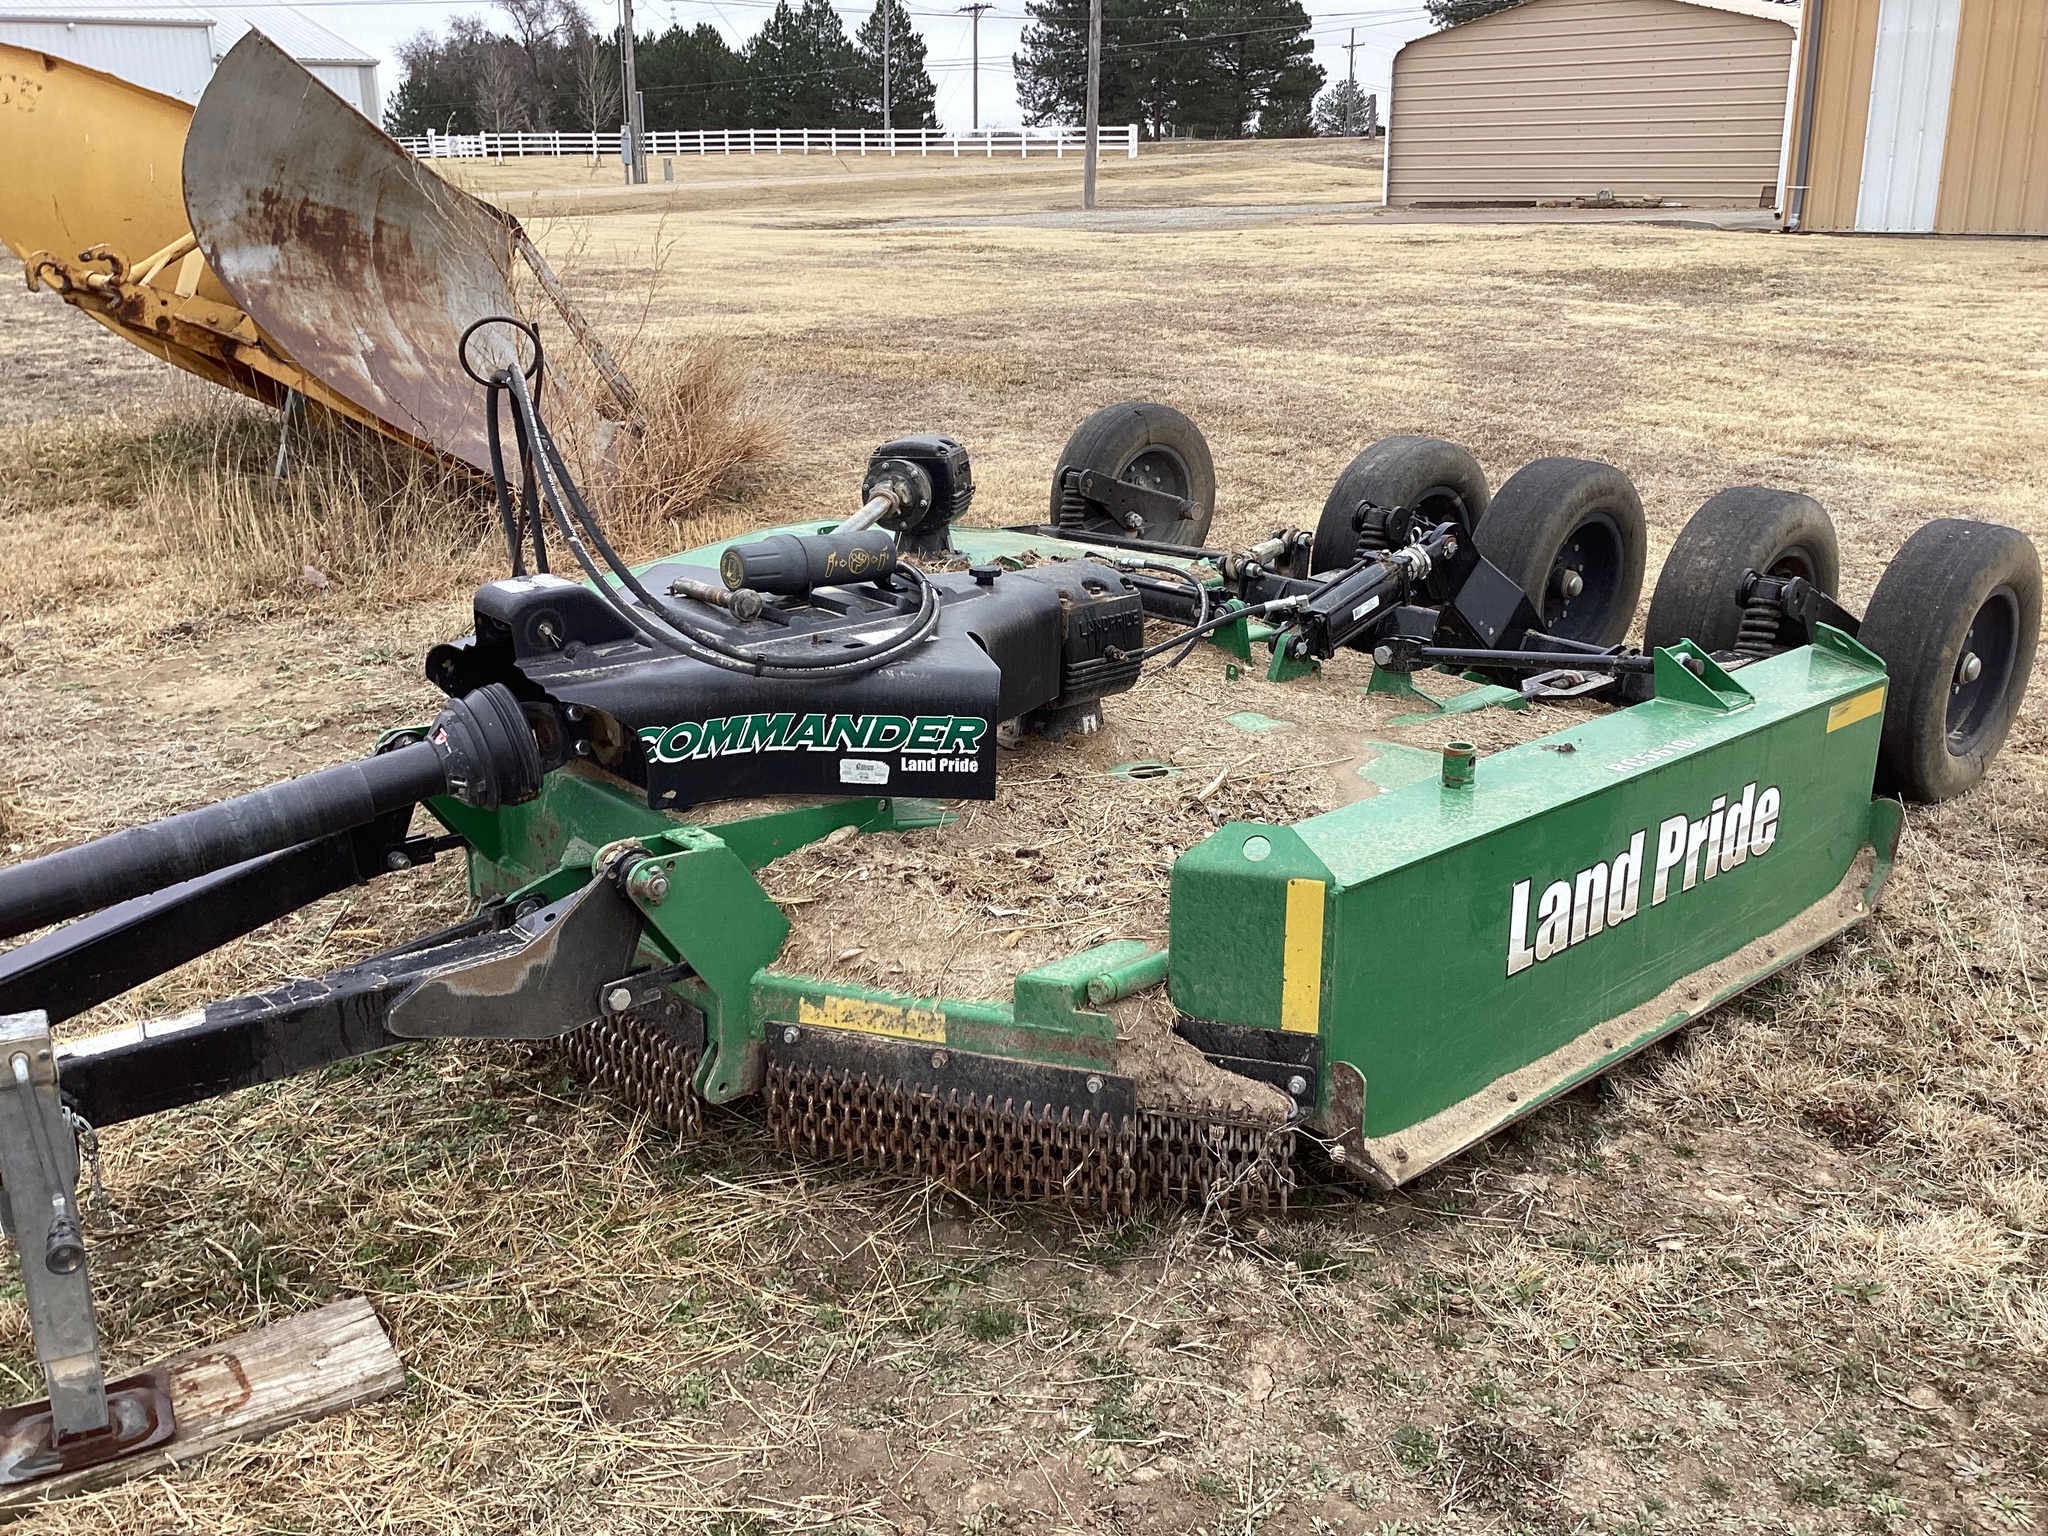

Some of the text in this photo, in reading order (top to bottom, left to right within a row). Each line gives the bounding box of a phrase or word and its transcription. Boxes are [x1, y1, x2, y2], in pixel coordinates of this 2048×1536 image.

[637, 713, 988, 764] COMMANDER
[1604, 739, 1698, 773] RC5610
[901, 756, 979, 773] Land Pride
[1506, 781, 1781, 978] Land Pride
